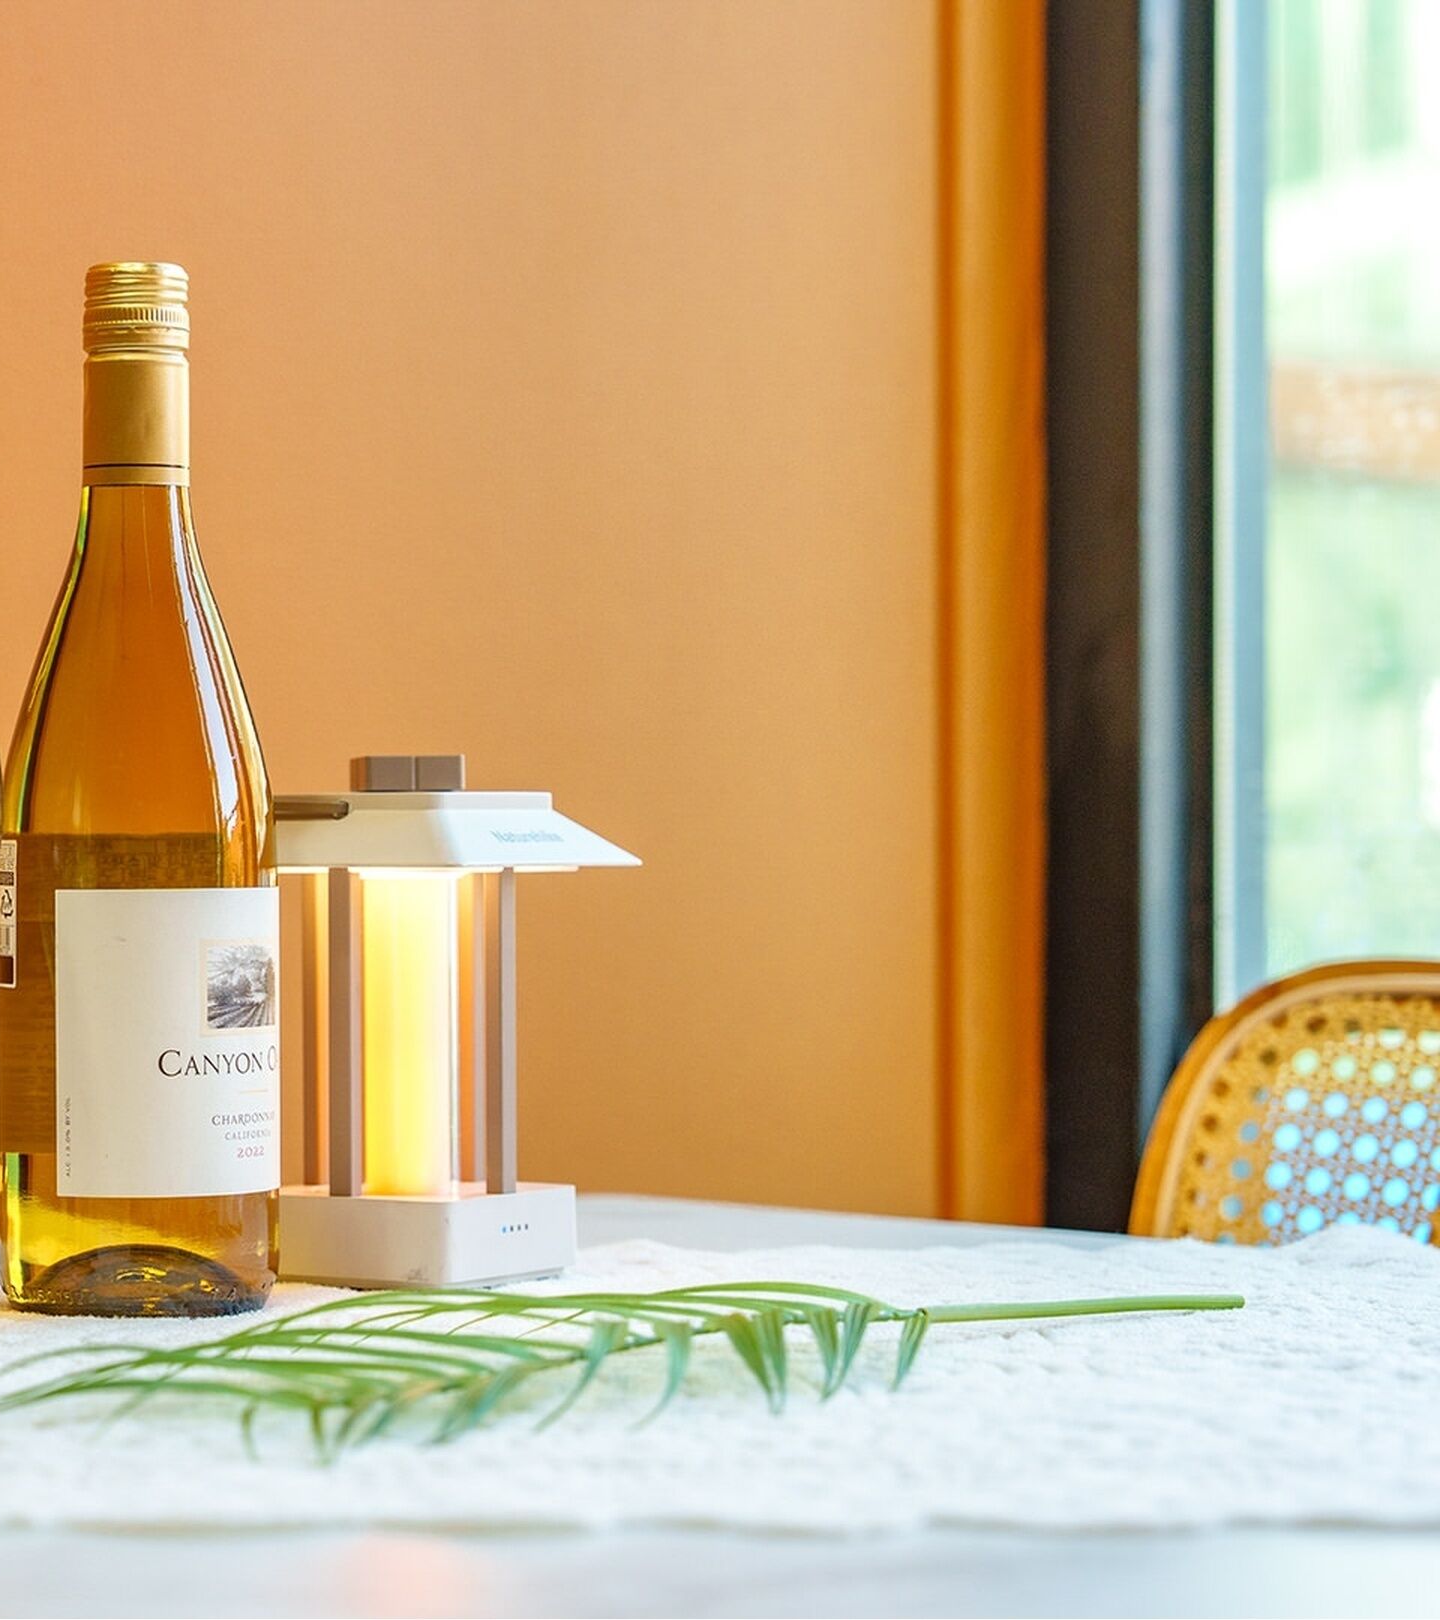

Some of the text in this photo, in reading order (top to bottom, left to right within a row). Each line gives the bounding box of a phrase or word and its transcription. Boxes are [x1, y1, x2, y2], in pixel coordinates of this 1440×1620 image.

[158, 1045, 277, 1077] CANYON O
[237, 1145, 264, 1158] 2022
